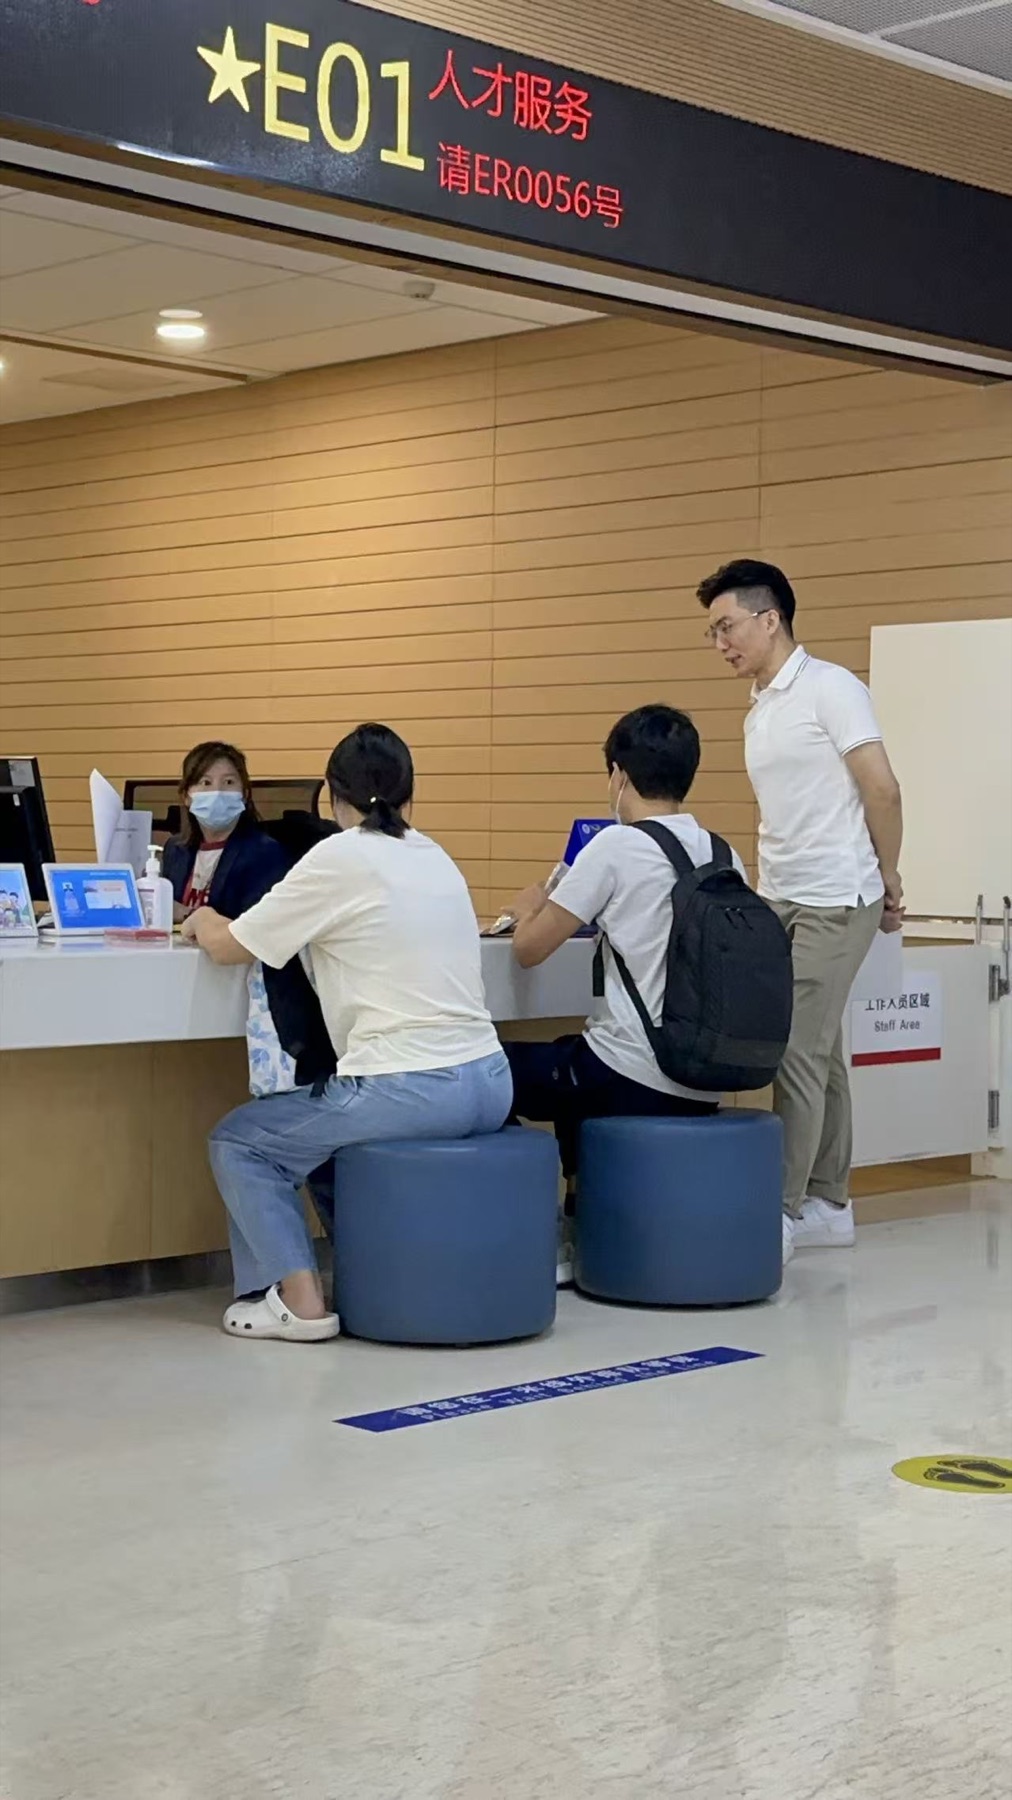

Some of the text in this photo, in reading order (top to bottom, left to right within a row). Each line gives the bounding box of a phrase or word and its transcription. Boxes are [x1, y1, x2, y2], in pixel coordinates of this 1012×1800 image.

[428, 49, 593, 141] 人才服务
[436, 140, 624, 229] 请ER0056号
[864, 992, 930, 1011] 工作人员区域
[874, 1019, 921, 1032] Staff Area
[420, 1404, 493, 1420] Please
